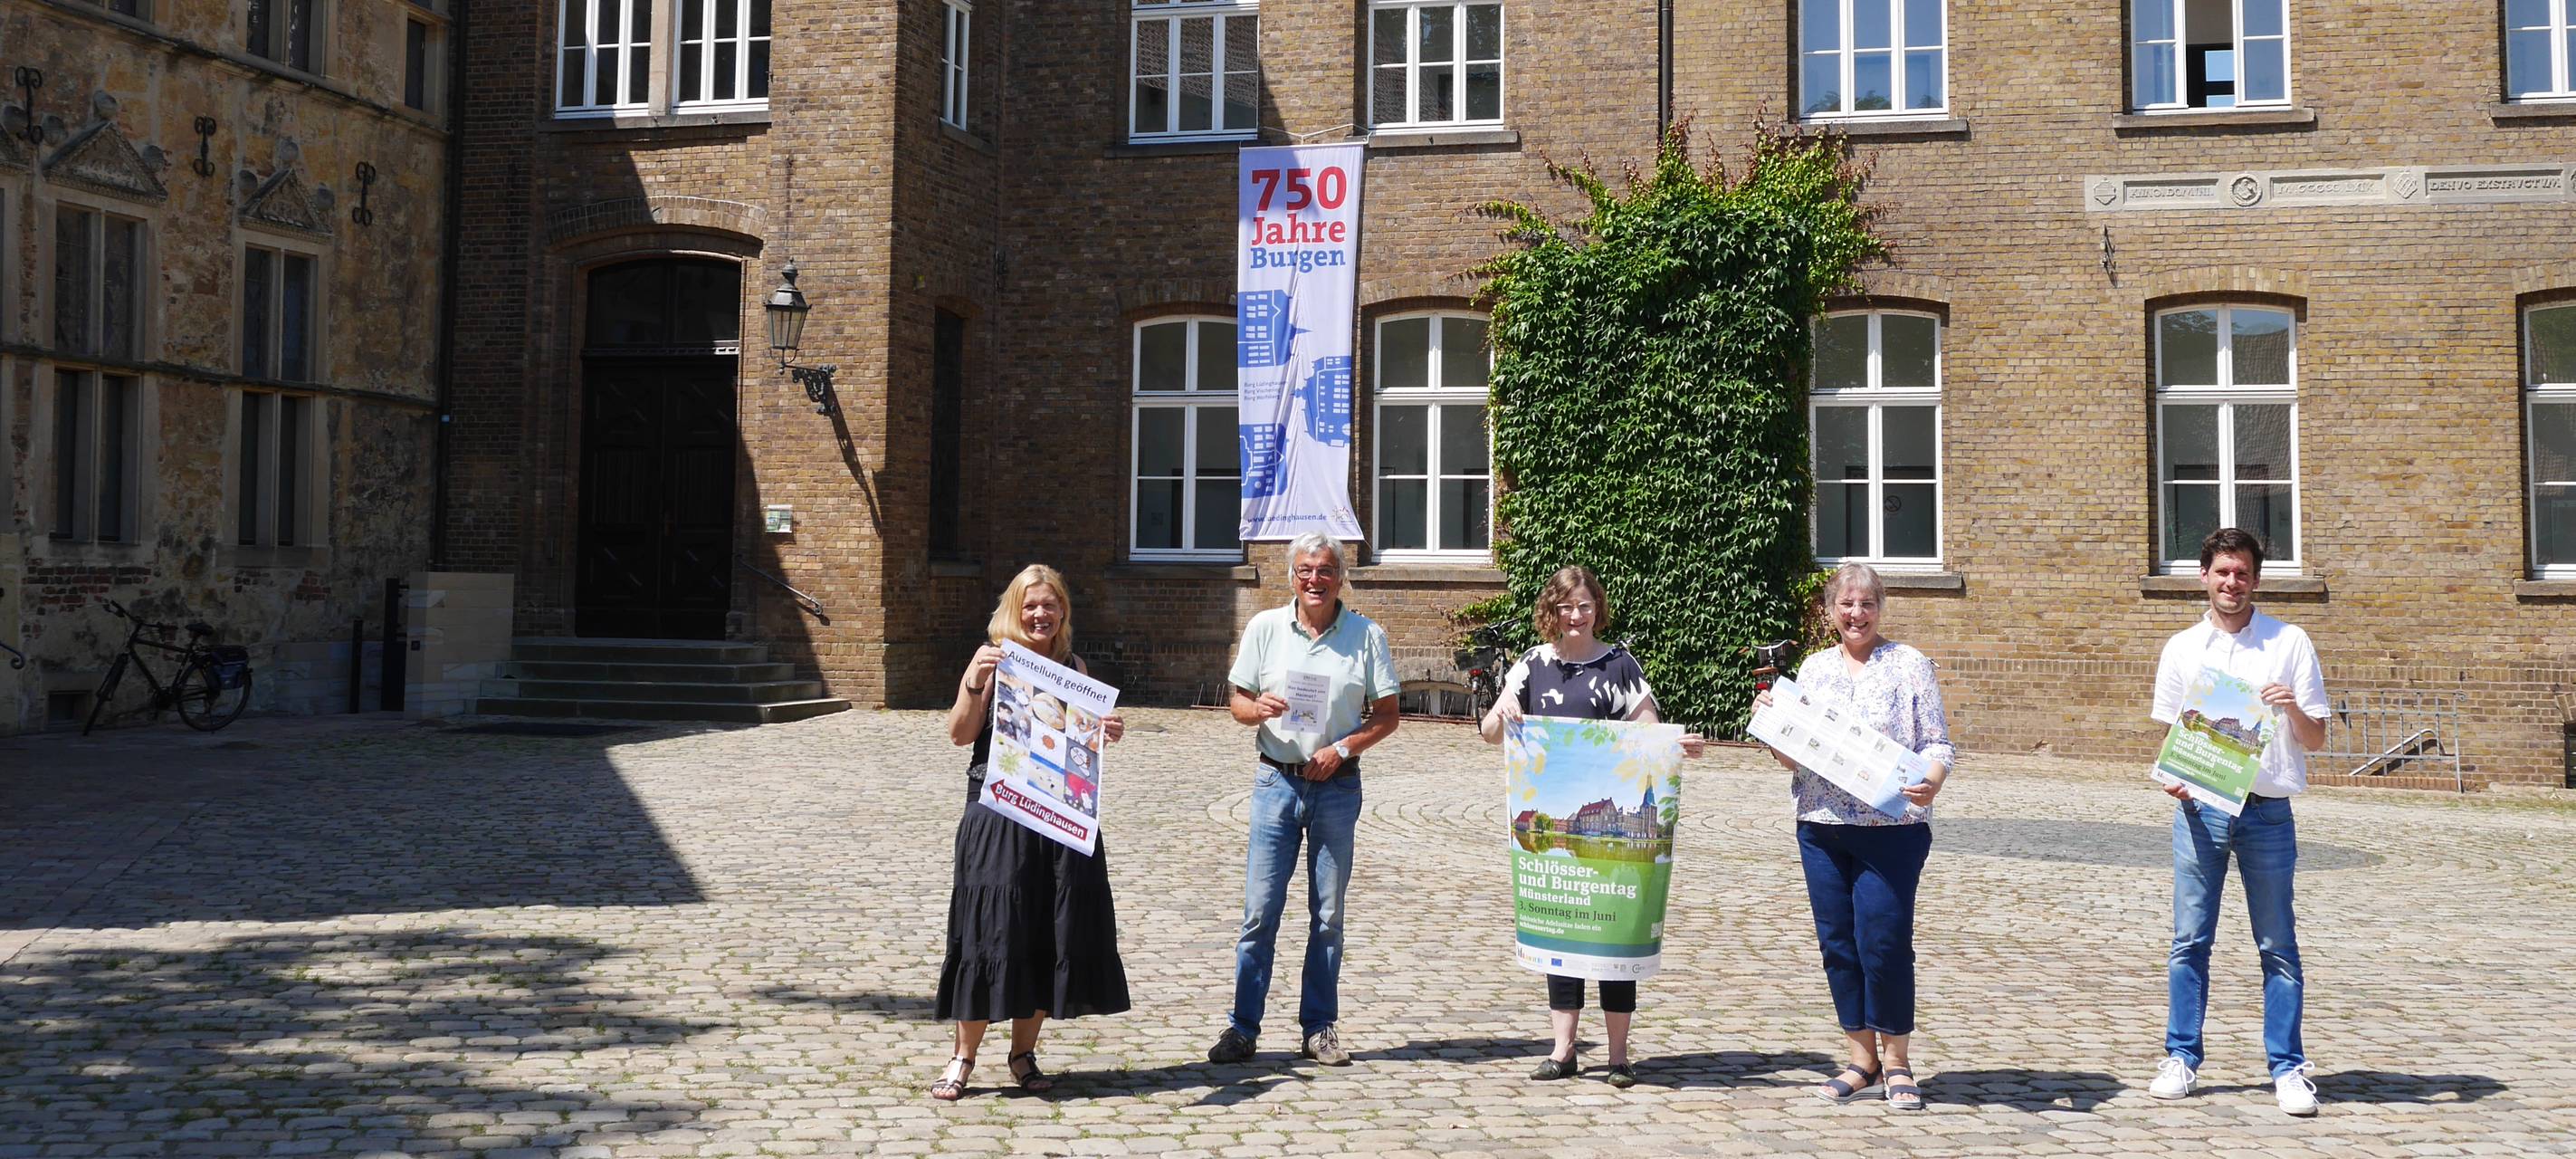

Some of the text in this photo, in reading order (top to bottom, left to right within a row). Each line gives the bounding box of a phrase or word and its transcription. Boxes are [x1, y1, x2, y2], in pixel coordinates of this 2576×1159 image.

[1251, 166, 1347, 211] 750
[1251, 213, 1346, 245] Jahre
[1250, 247, 1346, 273] Burgen
[1007, 650, 1108, 704] Ausstellung geöffnet
[2178, 729, 2226, 755] Schlösser-
[2171, 744, 2215, 770] Münsterland
[2175, 738, 2194, 751] und
[2195, 744, 2244, 774] Burgentag
[2175, 754, 2202, 771] Sonntag
[2202, 763, 2212, 773] im
[995, 783, 1084, 838] Burg Lüdinghausen
[1518, 856, 1599, 878] Schlösser-
[1518, 873, 1636, 899] und Burgentag
[1518, 886, 1591, 906] Münsterland
[1520, 901, 1617, 922] 3. Sonntag im Juni
